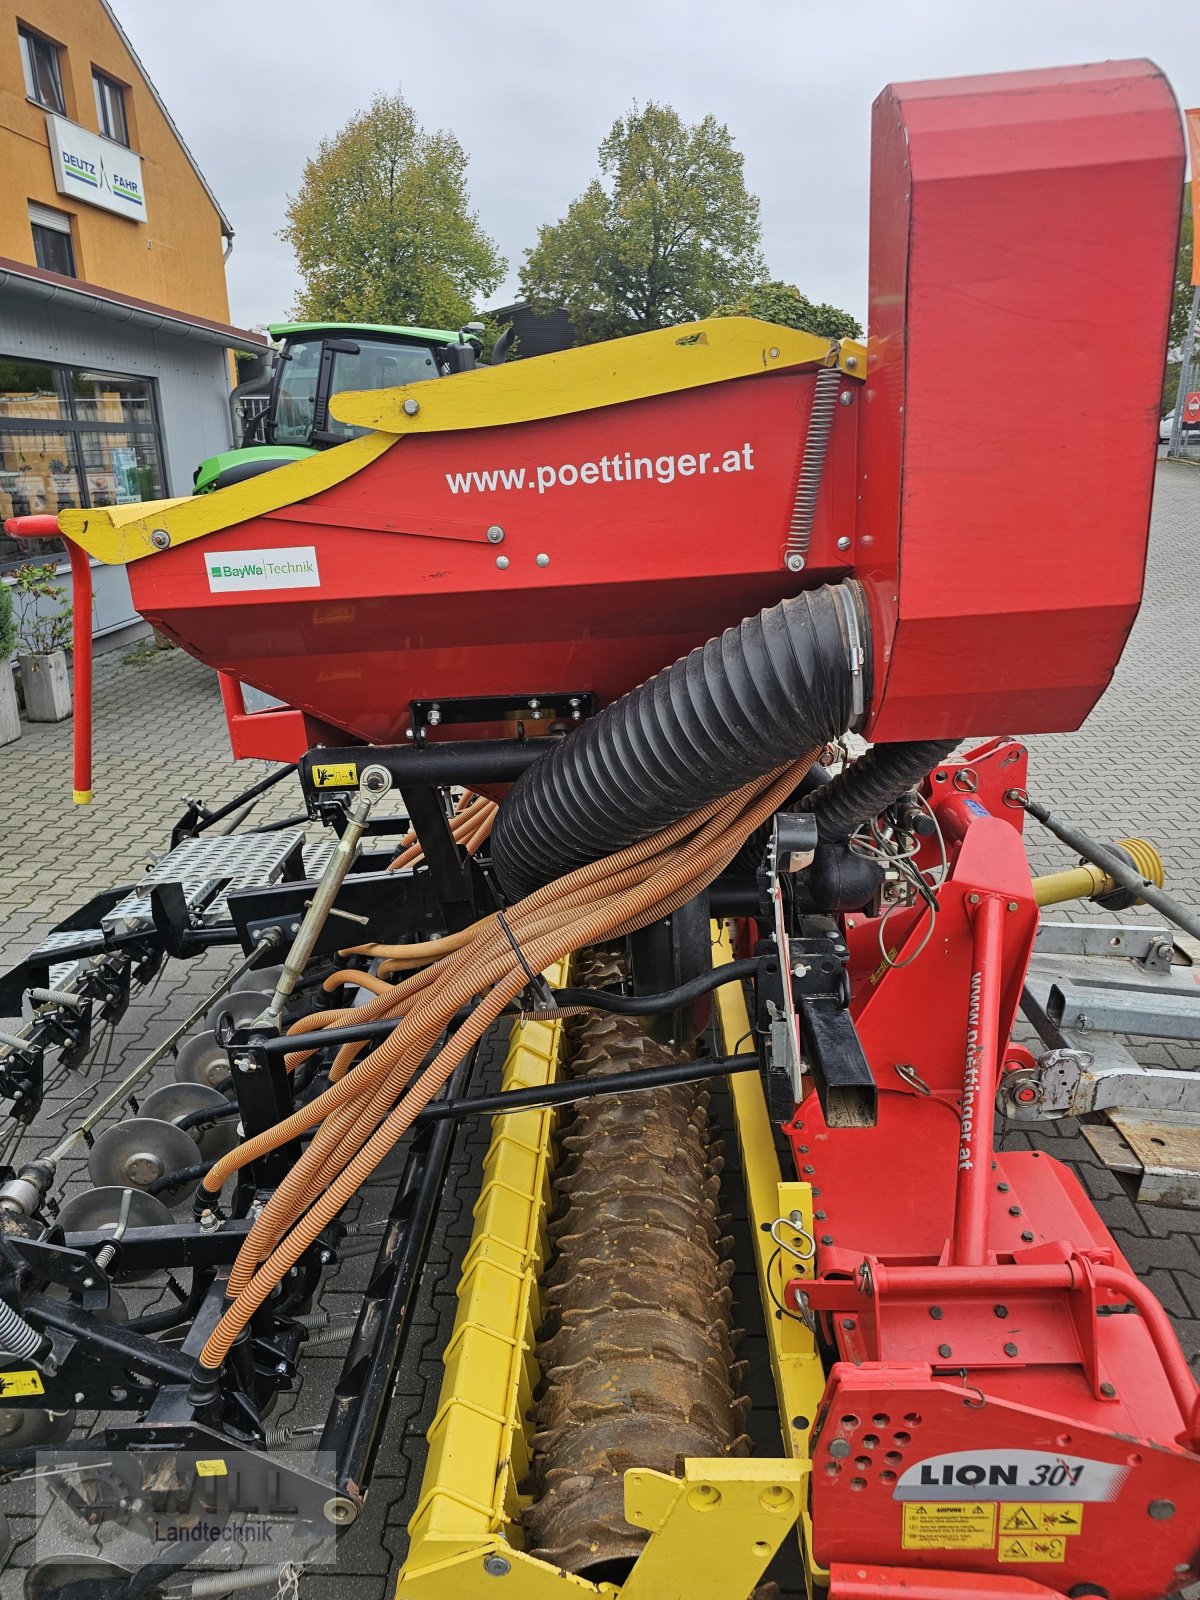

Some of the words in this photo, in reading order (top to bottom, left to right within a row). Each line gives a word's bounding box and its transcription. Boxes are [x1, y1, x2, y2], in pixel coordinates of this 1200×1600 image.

[62, 151, 96, 175] DEUTZ
[113, 174, 138, 193] FAHR
[445, 443, 755, 494] www.poettinger.at
[222, 565, 263, 578] BayWa
[266, 560, 314, 575] Technik
[958, 972, 982, 1171] www.poettinger.at
[920, 1464, 1018, 1486] LION
[1028, 1464, 1085, 1487] 301
